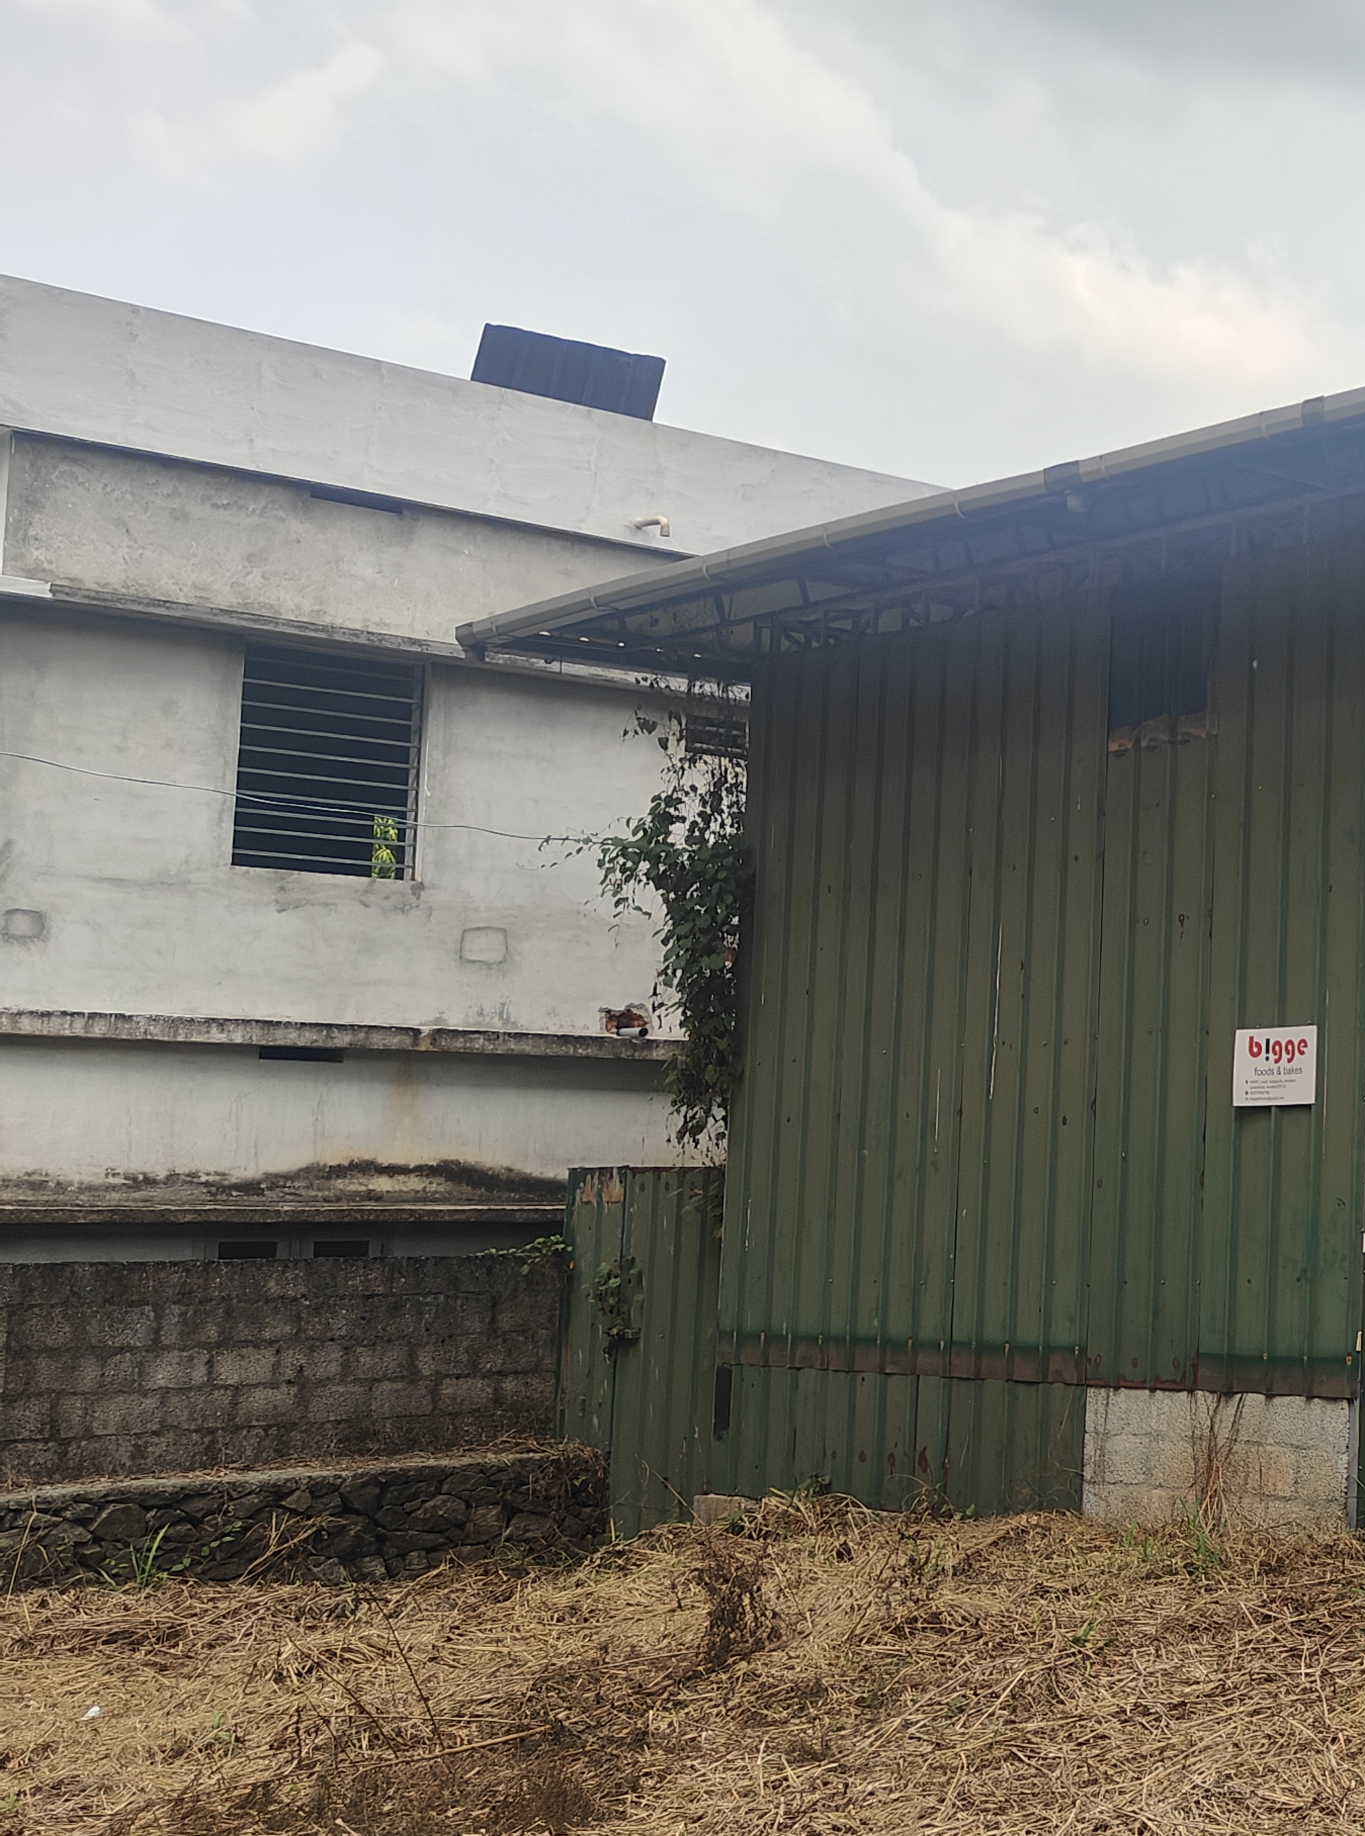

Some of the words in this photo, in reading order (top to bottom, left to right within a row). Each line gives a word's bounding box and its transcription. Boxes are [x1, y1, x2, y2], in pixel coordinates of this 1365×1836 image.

[1254, 1067, 1274, 1076] foods
[1276, 1066, 1281, 1075] &
[1283, 1066, 1303, 1075] bakes
